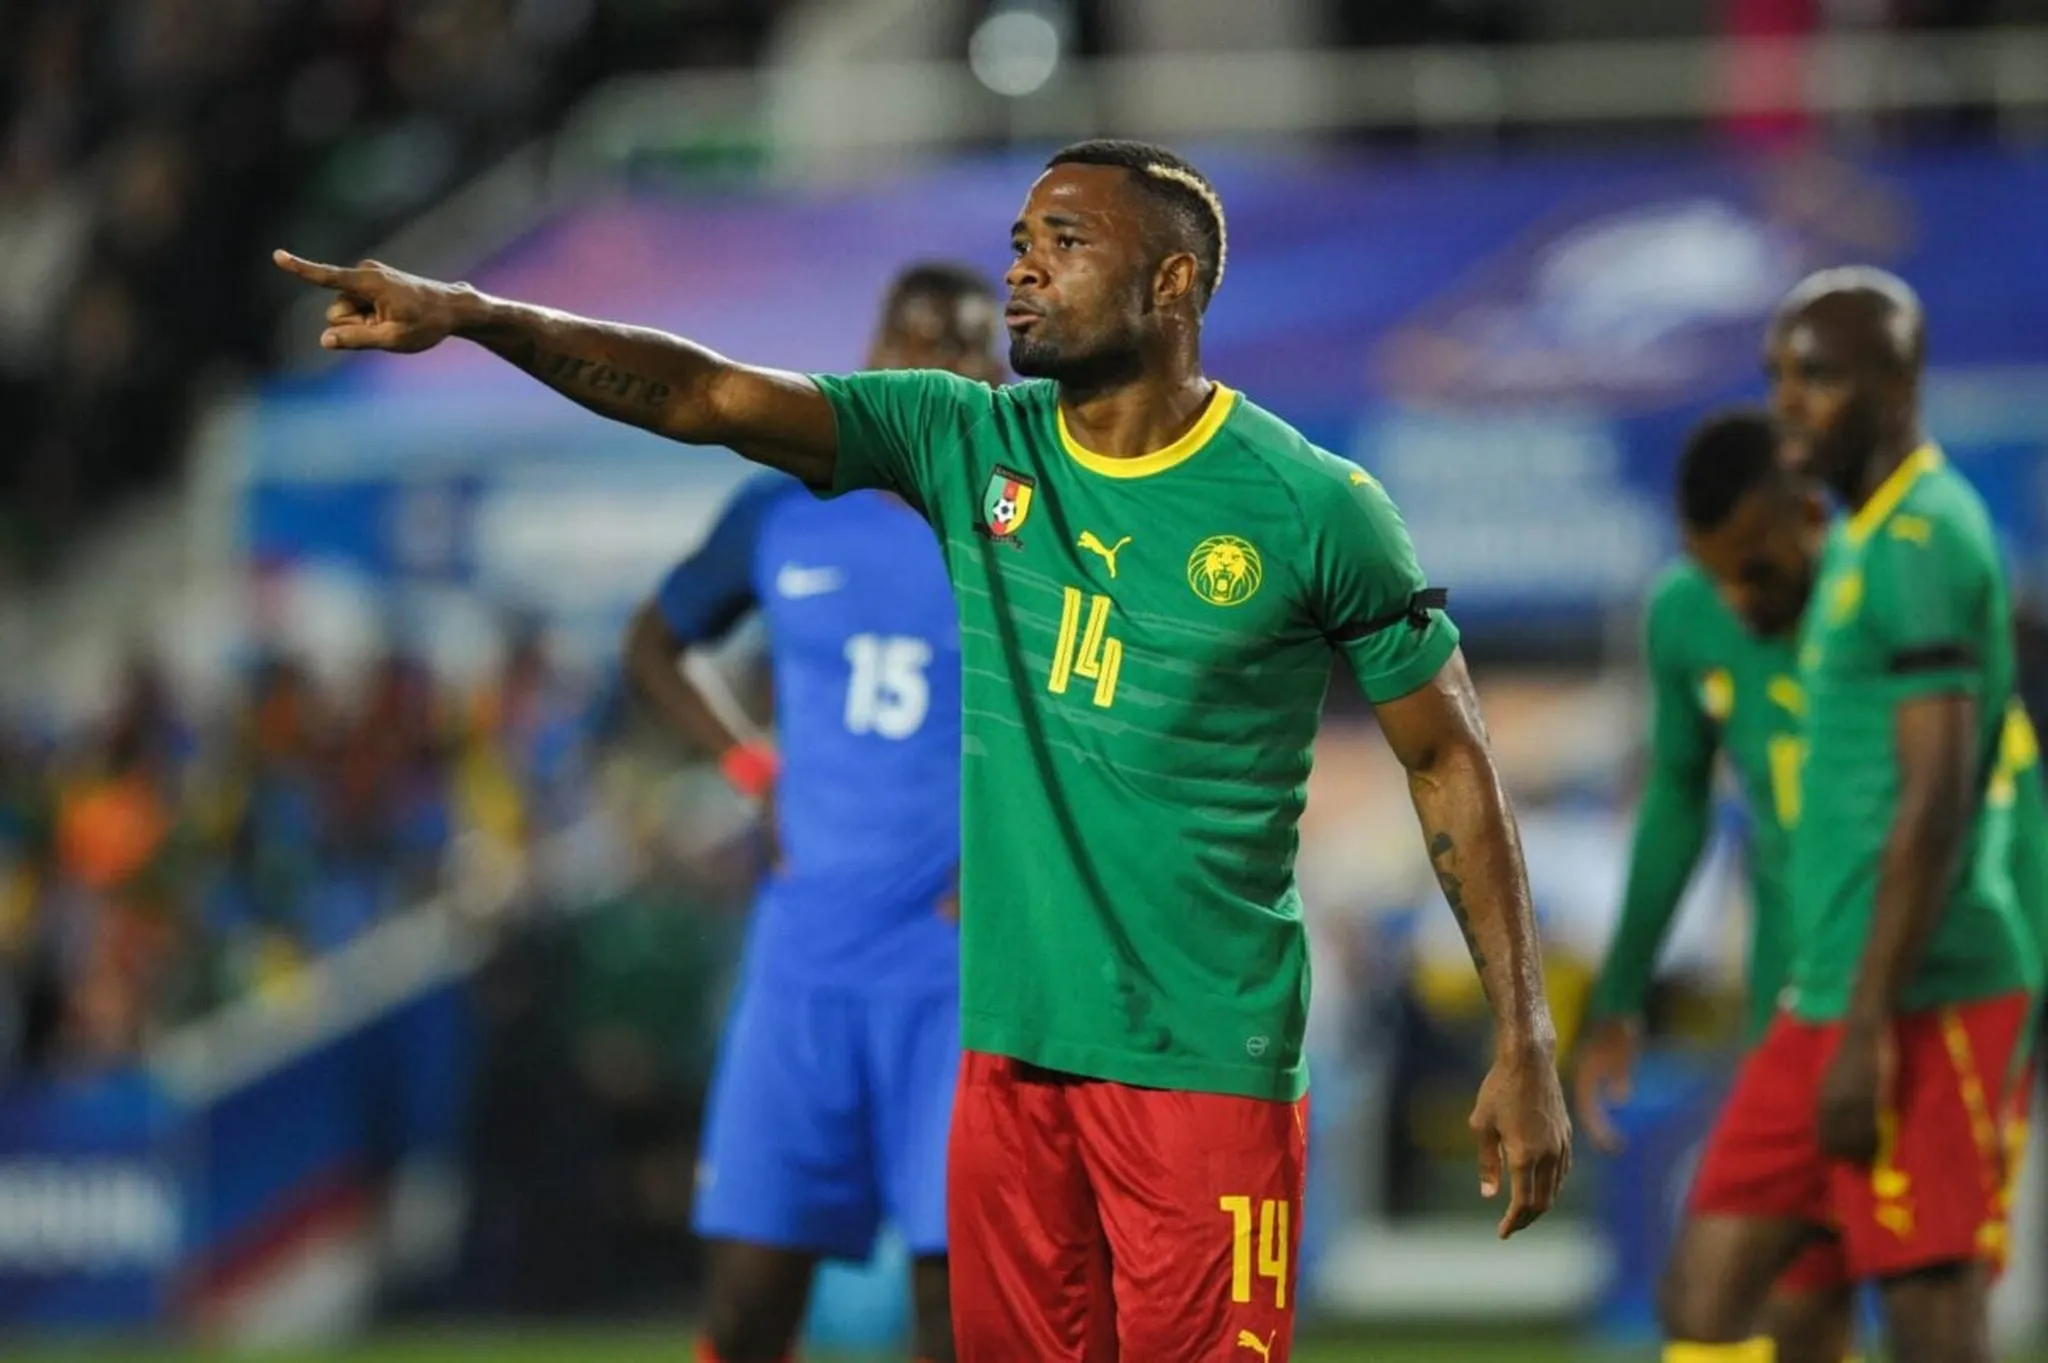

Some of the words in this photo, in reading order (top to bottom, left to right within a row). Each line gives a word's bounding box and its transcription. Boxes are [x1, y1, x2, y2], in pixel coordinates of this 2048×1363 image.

[844, 633, 932, 739] 15
[1048, 586, 1122, 708] 14
[1219, 1196, 1289, 1309] 14
